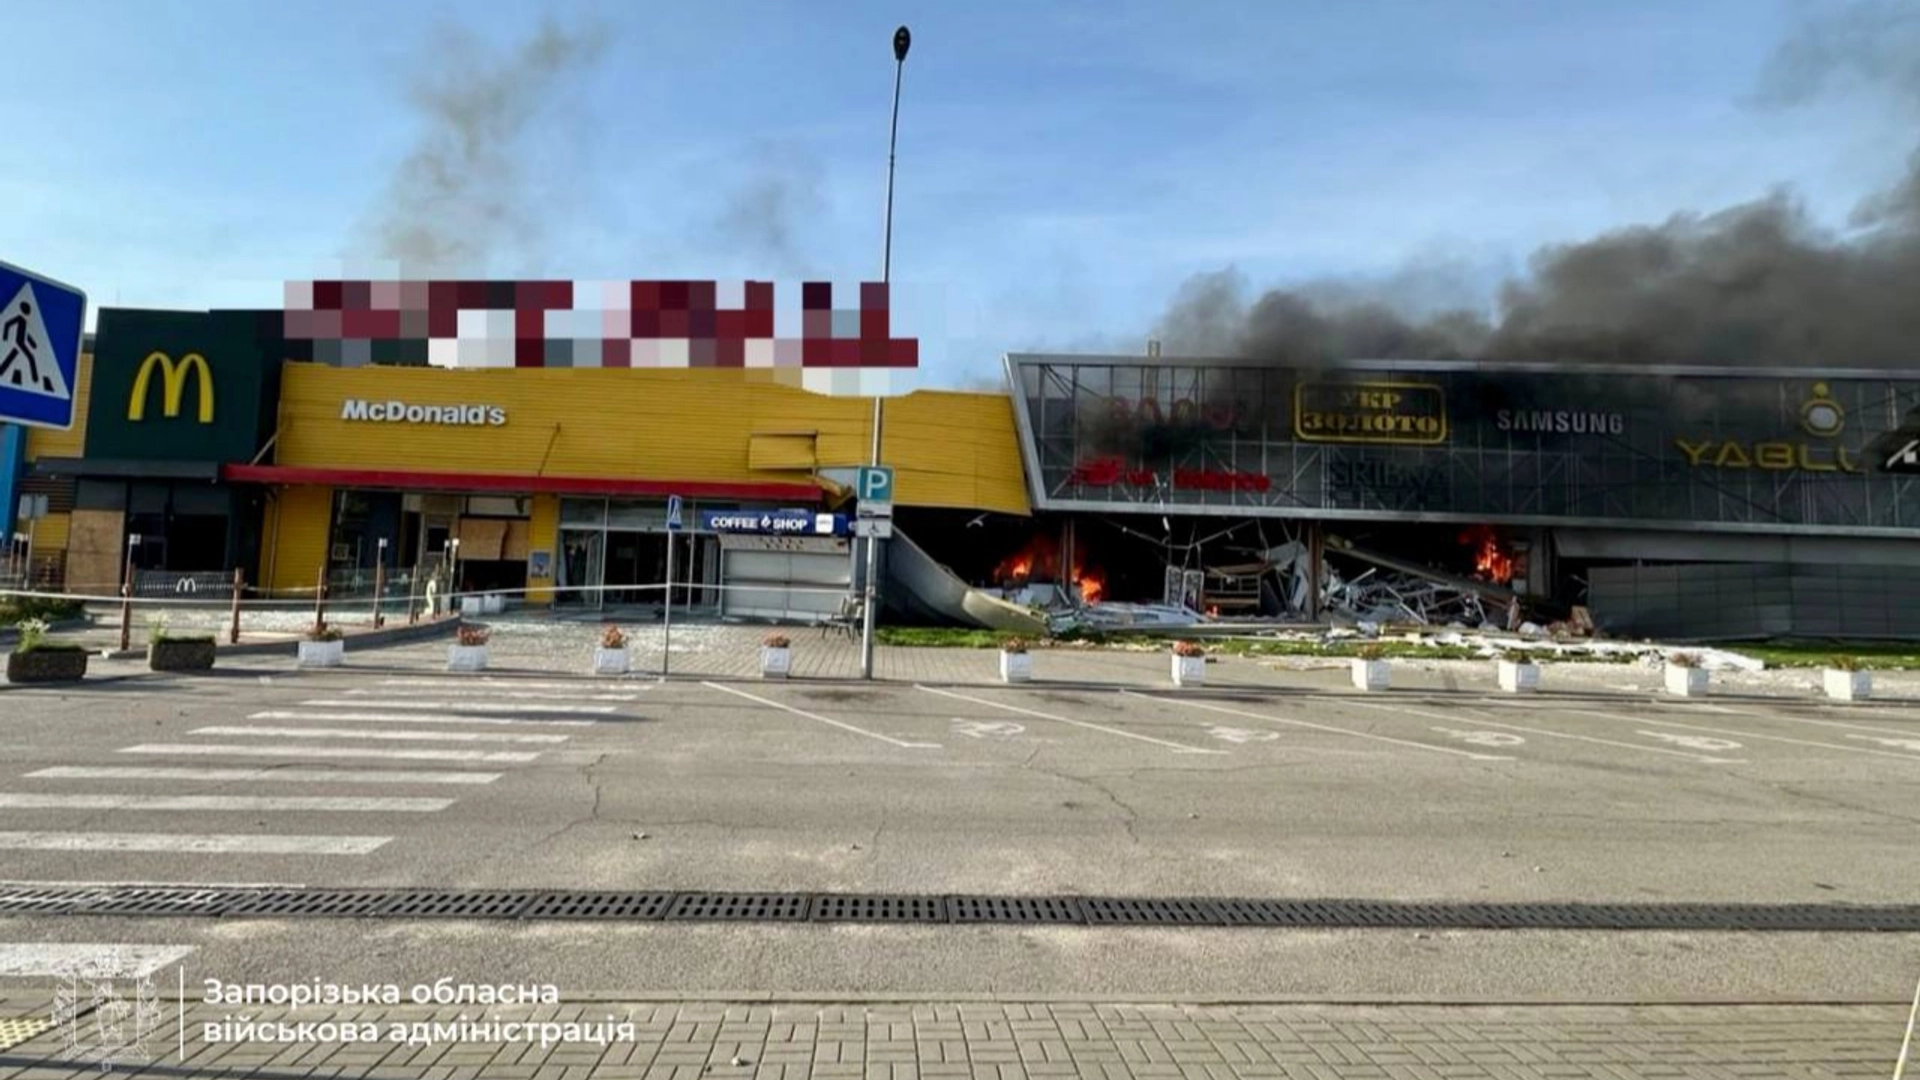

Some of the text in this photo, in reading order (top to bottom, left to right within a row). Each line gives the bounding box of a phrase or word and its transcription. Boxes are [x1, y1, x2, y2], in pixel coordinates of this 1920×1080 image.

[1341, 389, 1403, 409] УКР
[340, 399, 506, 426] McDonald's
[1302, 411, 1440, 434] ЗОЛОТО
[1496, 408, 1623, 436] SAMSUNG
[866, 469, 888, 498] P
[710, 516, 758, 529] COFFEE
[772, 517, 808, 531] SHOP
